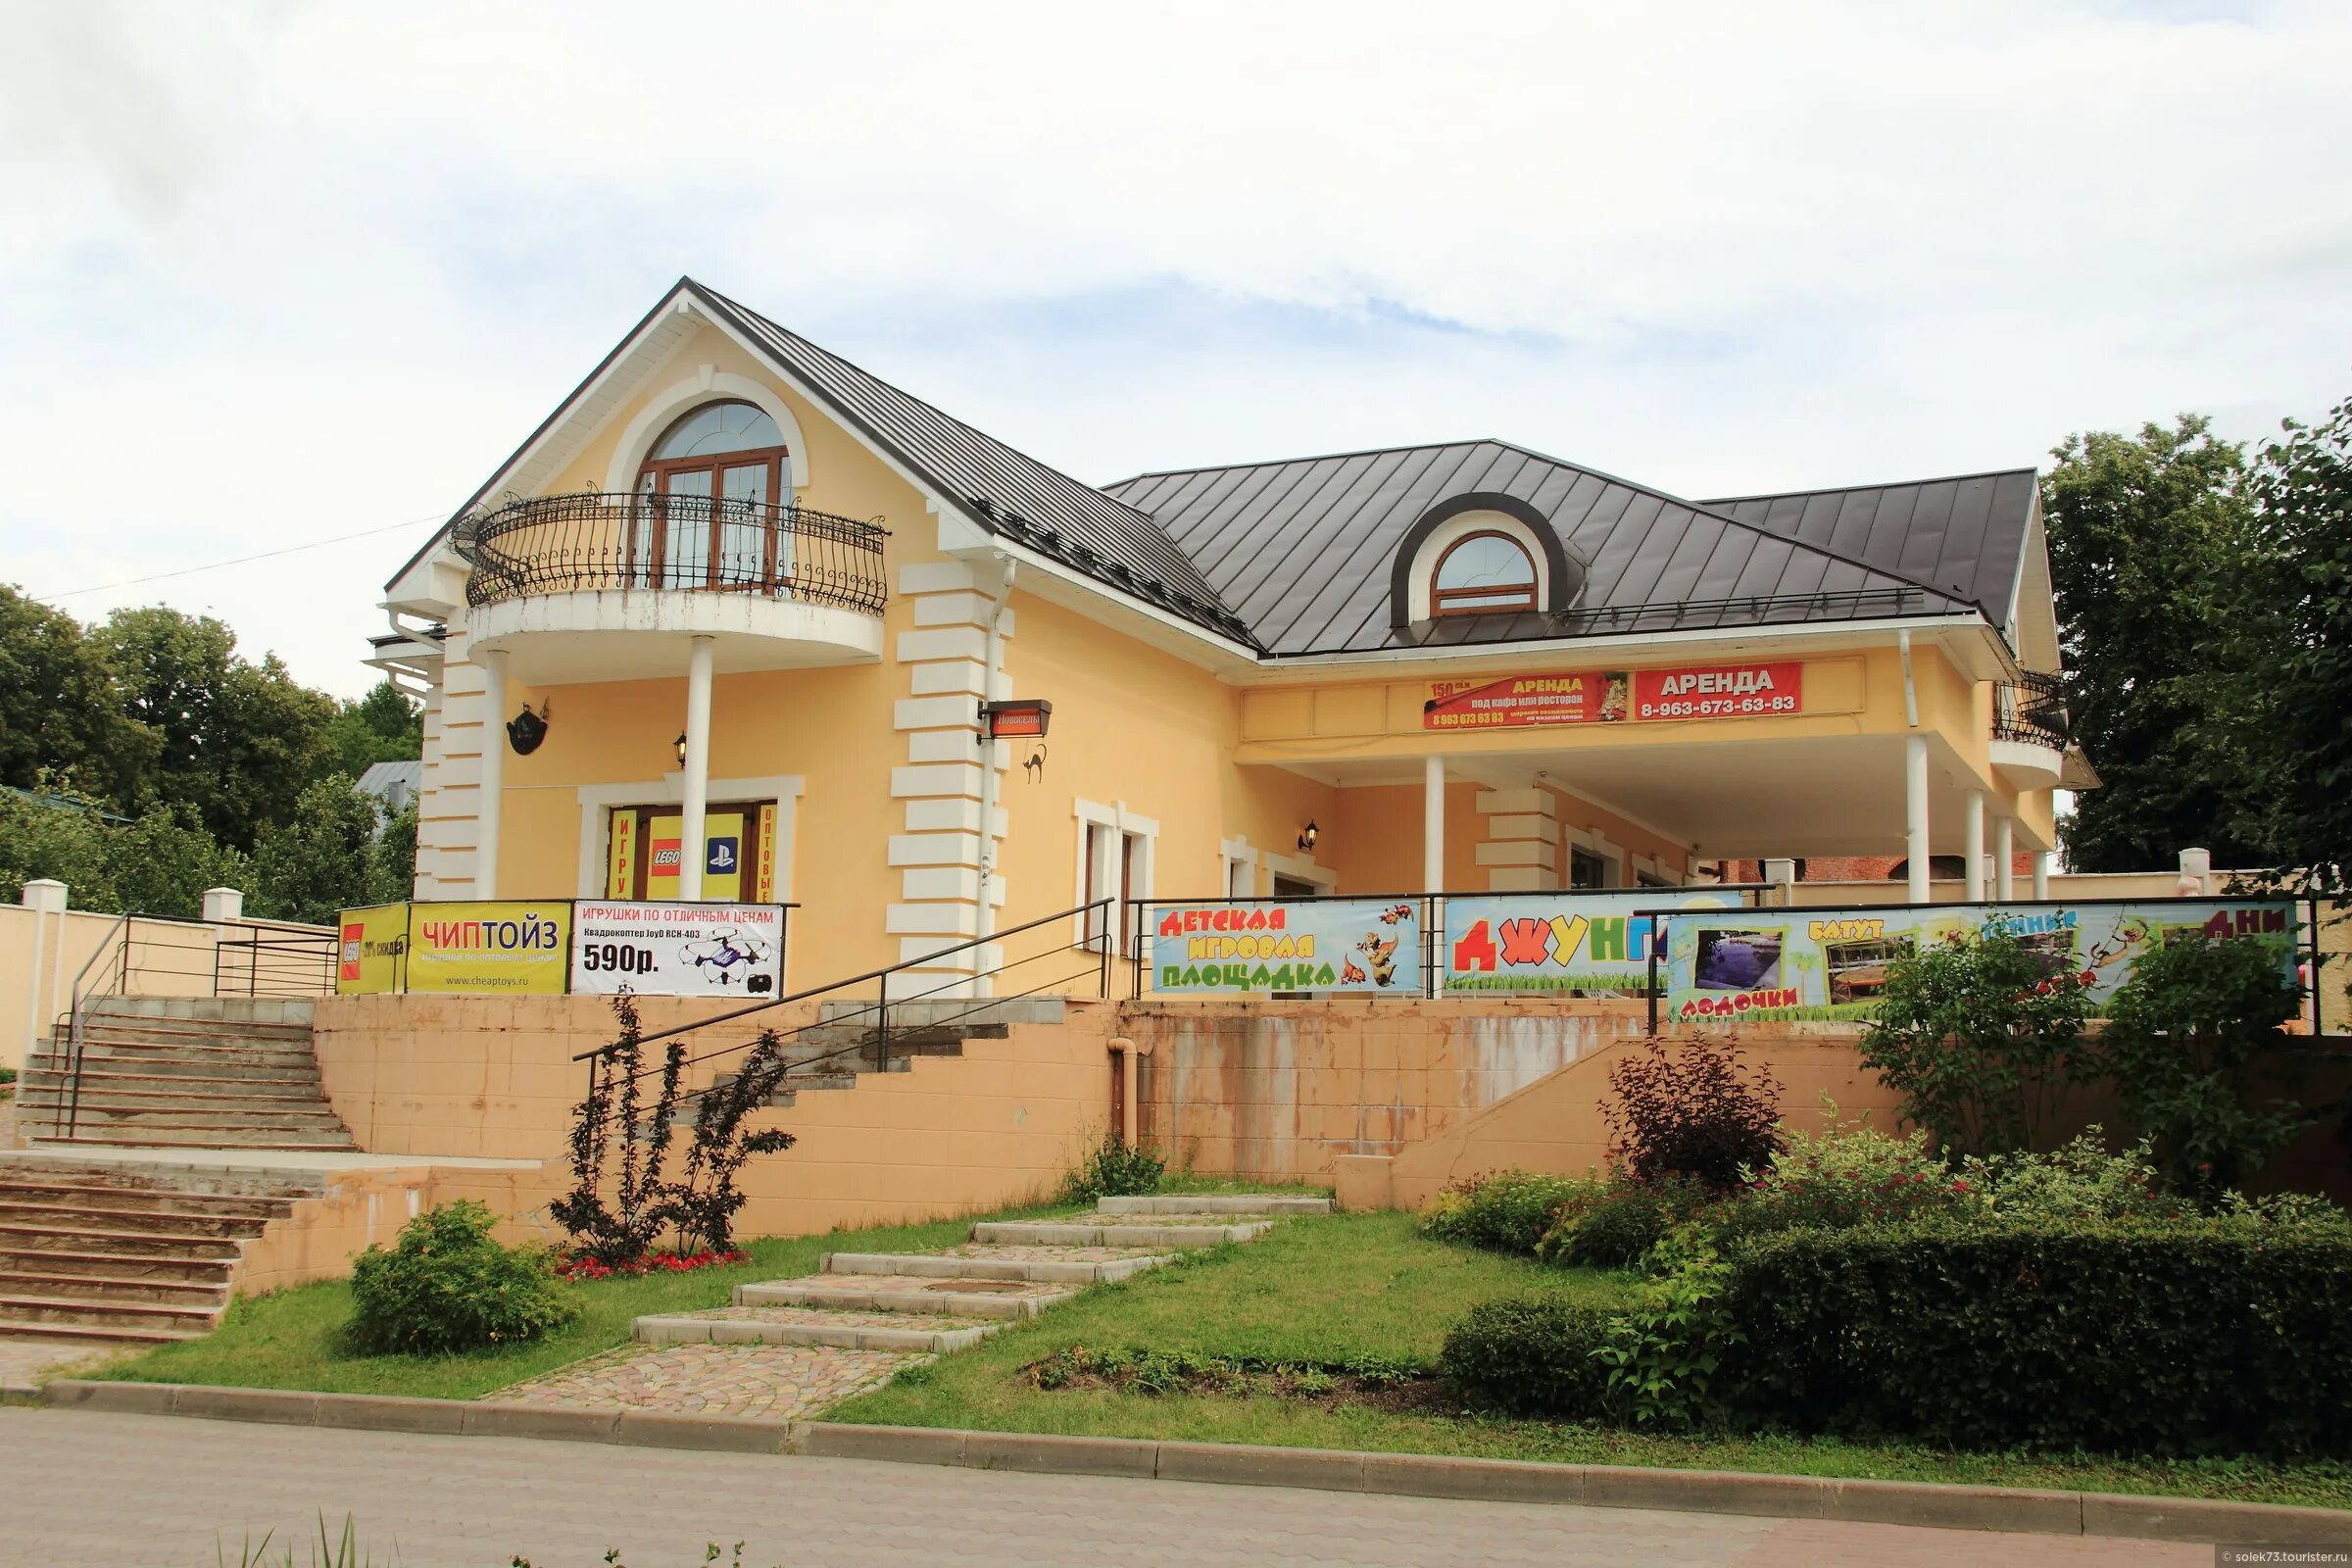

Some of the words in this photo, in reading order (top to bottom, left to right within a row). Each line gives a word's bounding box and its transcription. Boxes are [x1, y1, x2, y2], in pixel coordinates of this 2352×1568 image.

[1431, 682, 1452, 698] 150
[1512, 678, 1583, 694] АРЕНДА
[1661, 670, 1775, 696] АРЕНДА
[1471, 699, 1491, 709] под
[1492, 697, 1517, 708] кафе
[1518, 696, 1537, 707] или
[1538, 694, 1583, 706] ресторан
[1641, 696, 1795, 717] 8-963-673-63-83
[1433, 714, 1440, 725] 8
[1441, 713, 1458, 724] 963
[1459, 712, 1476, 724] 673
[1477, 712, 1490, 723] 63
[1491, 711, 1503, 723] 83
[655, 851, 681, 864] LEGO
[582, 907, 640, 920] ИГРУШКИ
[644, 909, 660, 921] ПО
[663, 910, 730, 923] ОТЛИЧНЫМ
[734, 911, 774, 924] ЦЕНАМ
[1159, 908, 1286, 937] ДЕТСКАЯ
[422, 912, 559, 951] ЧИПТОЙЗ
[584, 928, 644, 938] Квадрокоптер
[646, 930, 664, 939] JoyD
[1808, 919, 1884, 941] БАТУТ
[1188, 934, 1315, 961] ИГРОВАЯ
[584, 944, 659, 975] 590р.
[446, 976, 528, 987] www.cheaptoys.ru
[1162, 962, 1337, 992] ПЛОЩАДКА
[1680, 988, 1798, 1017] ЛОДОЧКИ
